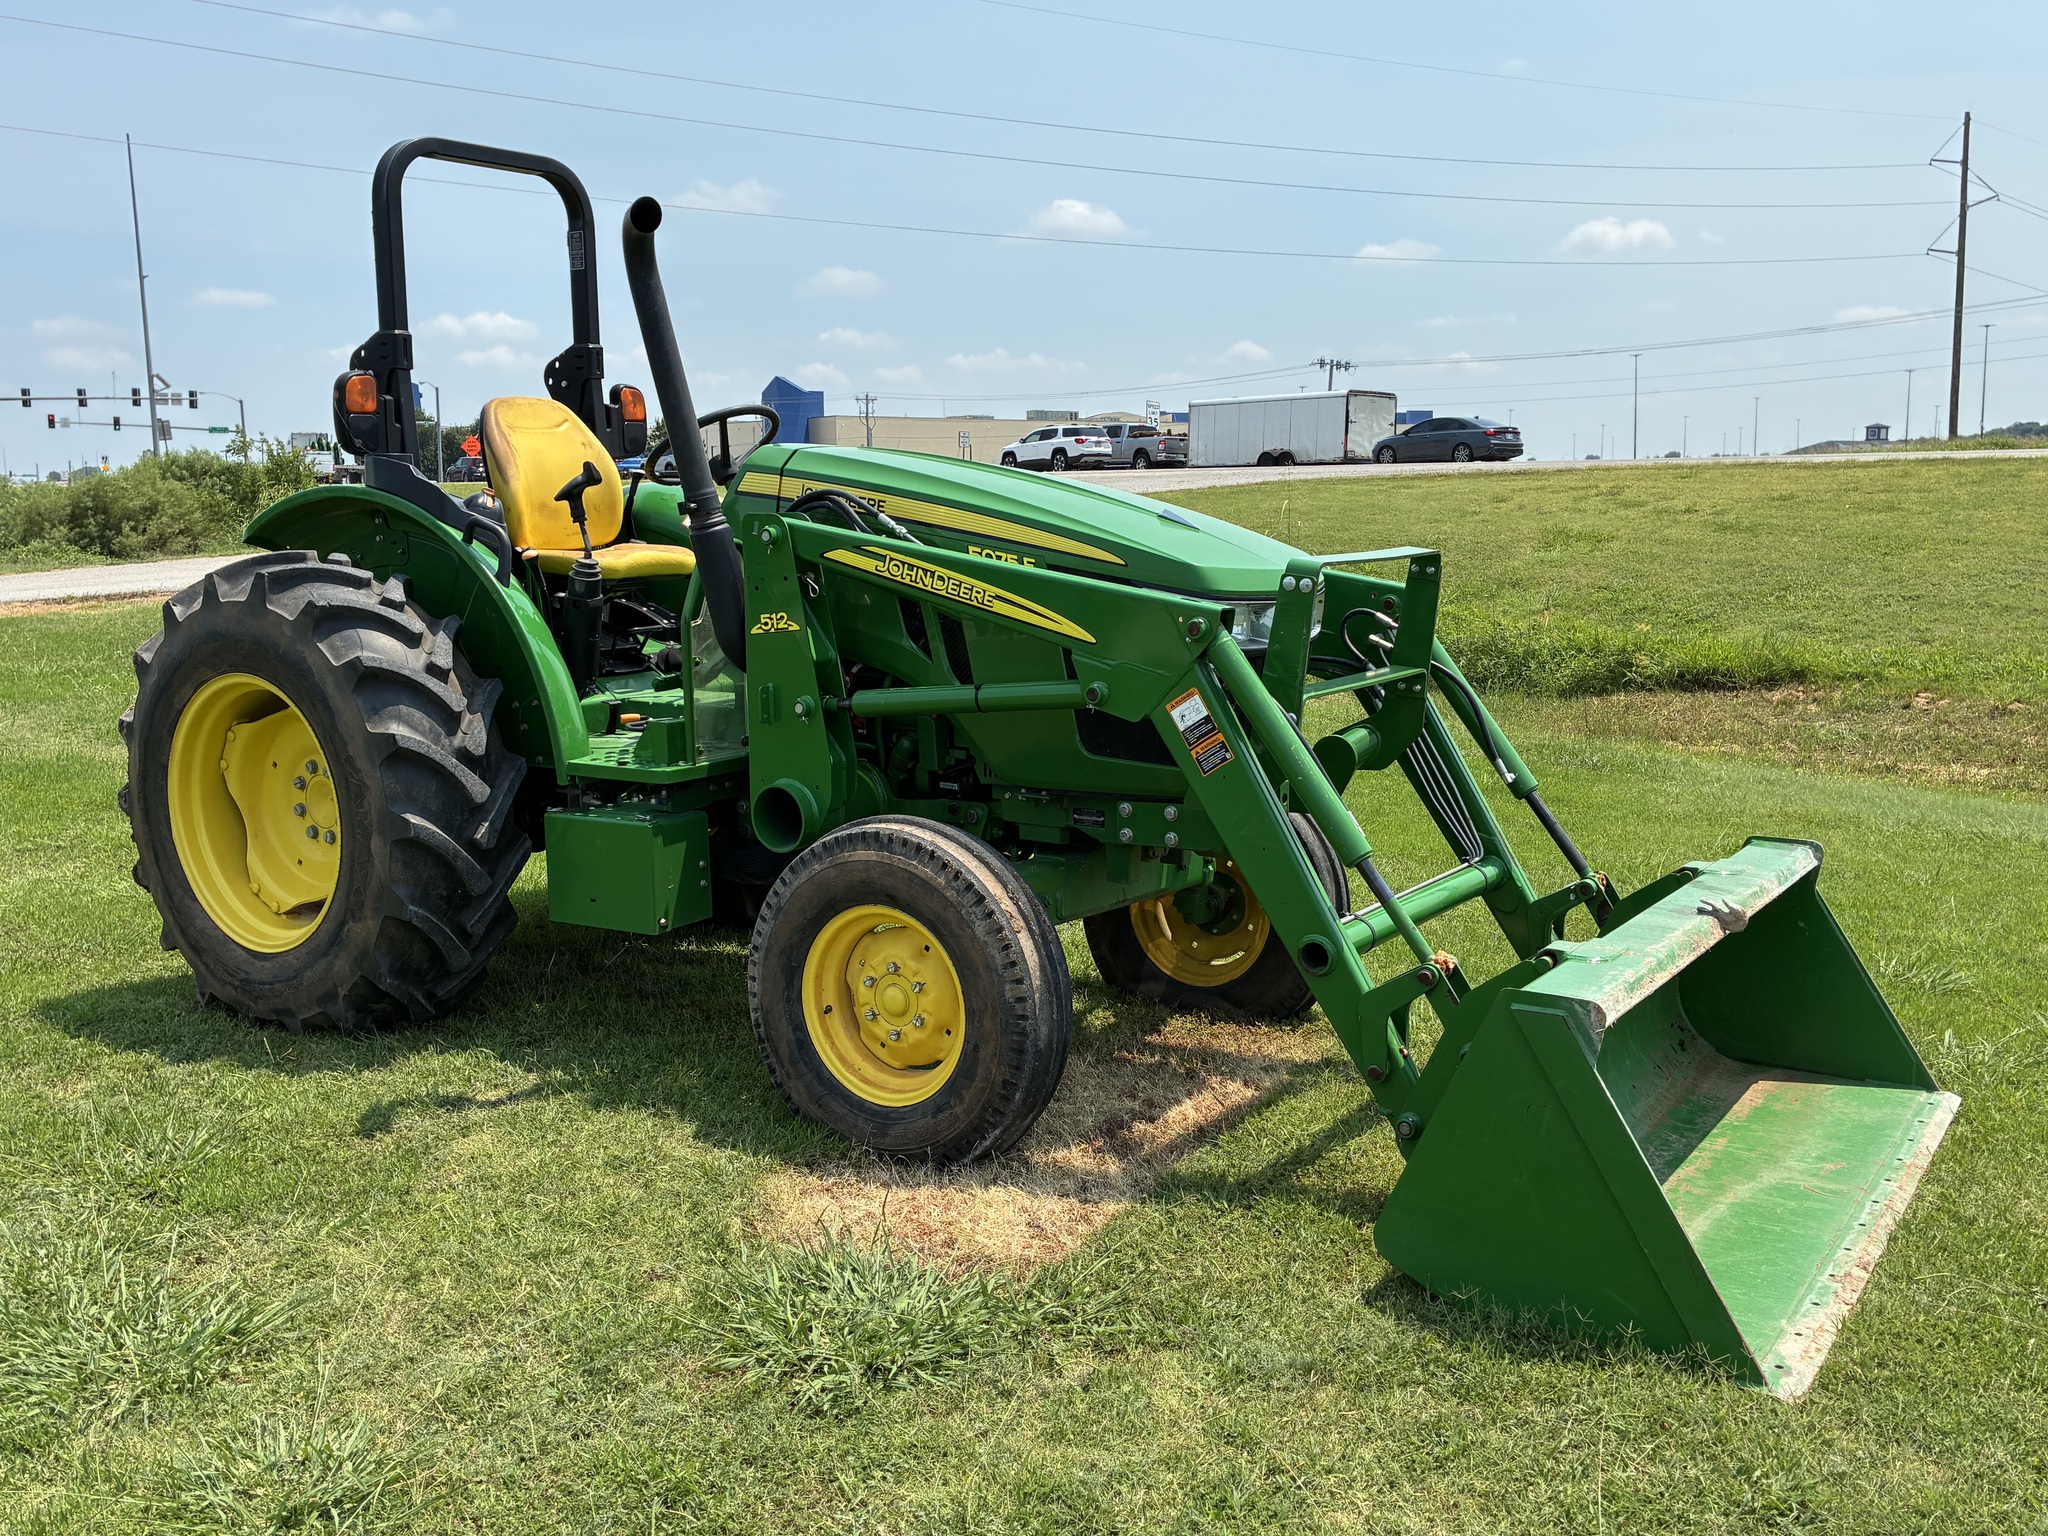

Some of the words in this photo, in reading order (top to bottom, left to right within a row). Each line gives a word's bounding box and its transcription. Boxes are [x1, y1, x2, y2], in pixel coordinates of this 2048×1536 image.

[1148, 416, 1158, 427] 35
[875, 554, 932, 588] JOHN
[931, 569, 996, 608] DEERE
[759, 612, 789, 631] 512
[1174, 690, 1195, 706] WARNING
[1199, 736, 1221, 751] WARNING
